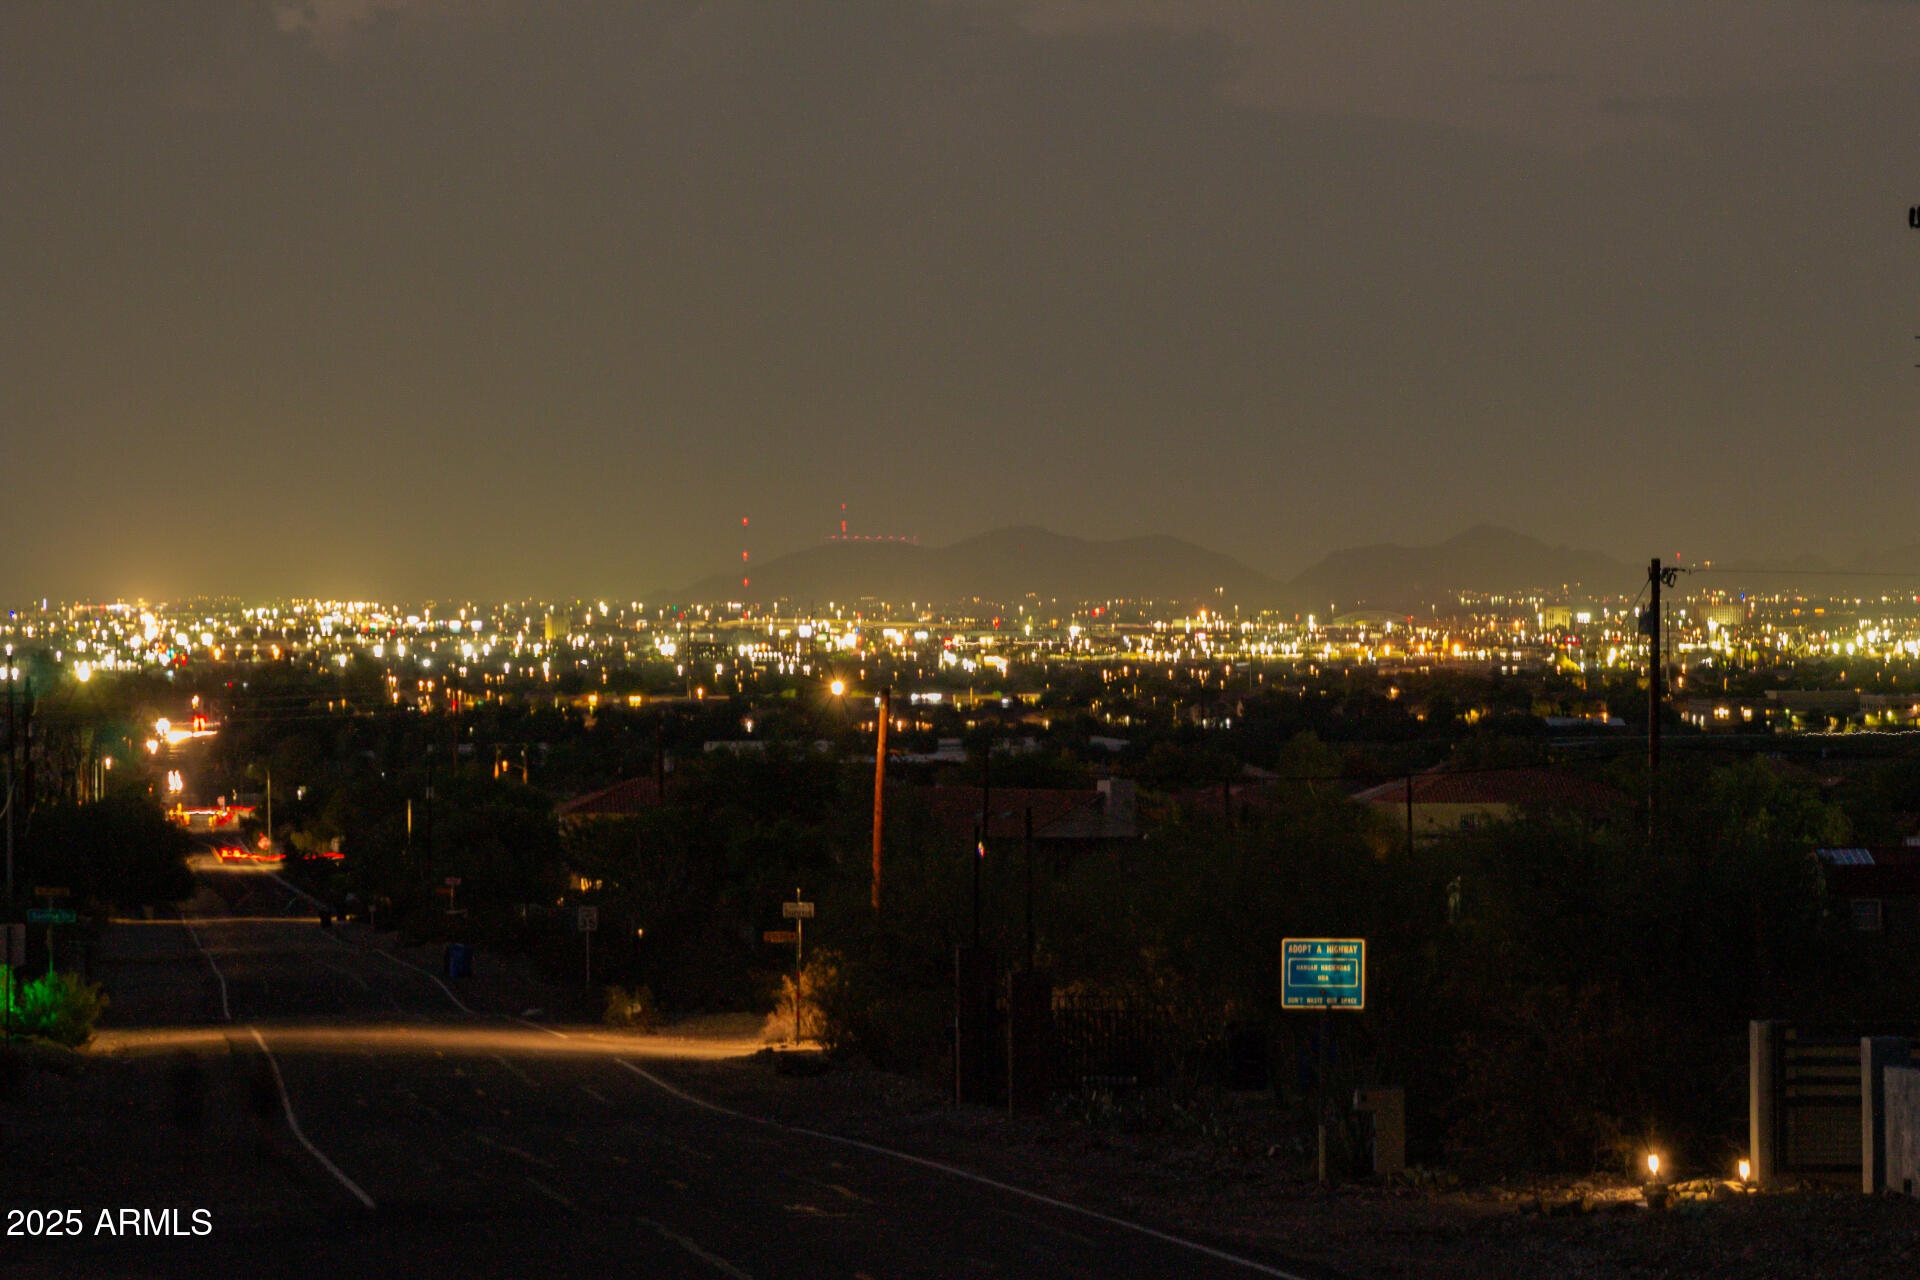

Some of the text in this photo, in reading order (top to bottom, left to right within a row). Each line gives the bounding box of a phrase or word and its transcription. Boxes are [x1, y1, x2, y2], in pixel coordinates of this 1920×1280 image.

[1288, 944, 1358, 954] ADOPT A HIGHWAY
